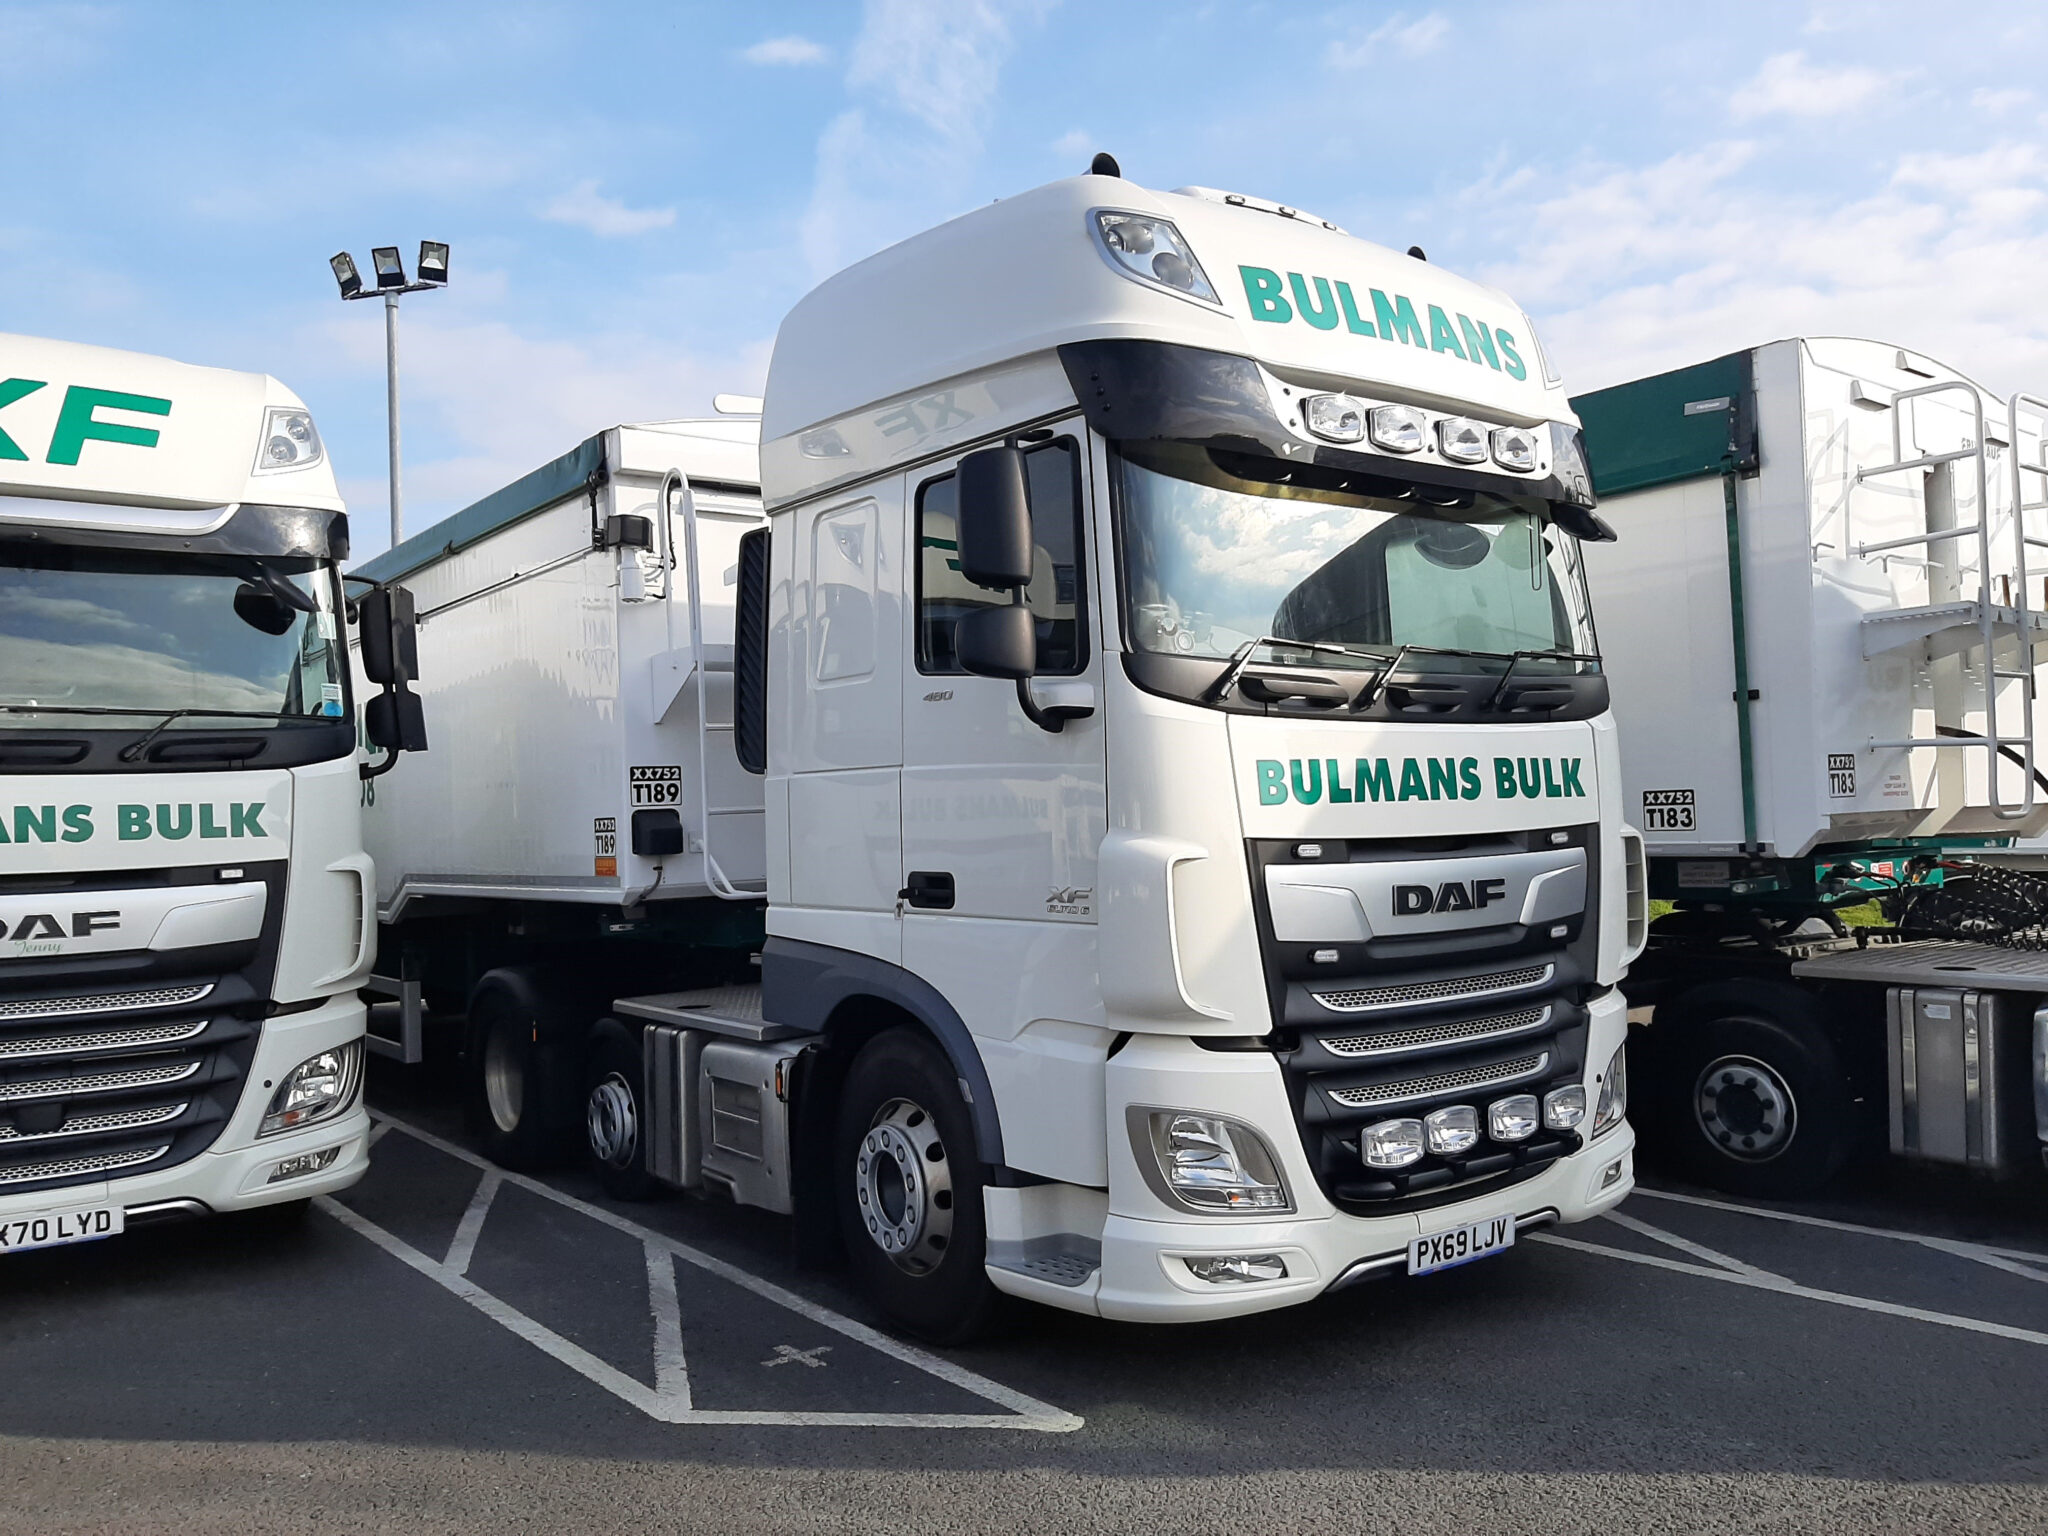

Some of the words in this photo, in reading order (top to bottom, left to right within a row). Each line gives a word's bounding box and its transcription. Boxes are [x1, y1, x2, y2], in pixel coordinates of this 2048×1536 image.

[1237, 264, 1527, 382] BULMANS
[1829, 756, 1855, 769] XX752
[632, 767, 681, 780] XX752
[1255, 756, 1482, 807] BULMANS
[1492, 756, 1587, 799] BULK
[1830, 772, 1855, 795] T183
[633, 783, 680, 803] T189
[1645, 791, 1694, 804] XX752
[117, 802, 269, 842] BULK
[595, 818, 616, 831] XX752
[1645, 807, 1693, 828] T183
[595, 834, 616, 855] T189
[1045, 886, 1093, 904] XF
[1391, 877, 1506, 917] DAF
[57, 1209, 112, 1239] LYD
[1417, 1230, 1468, 1268] PX69
[1472, 1218, 1507, 1252] LJV
